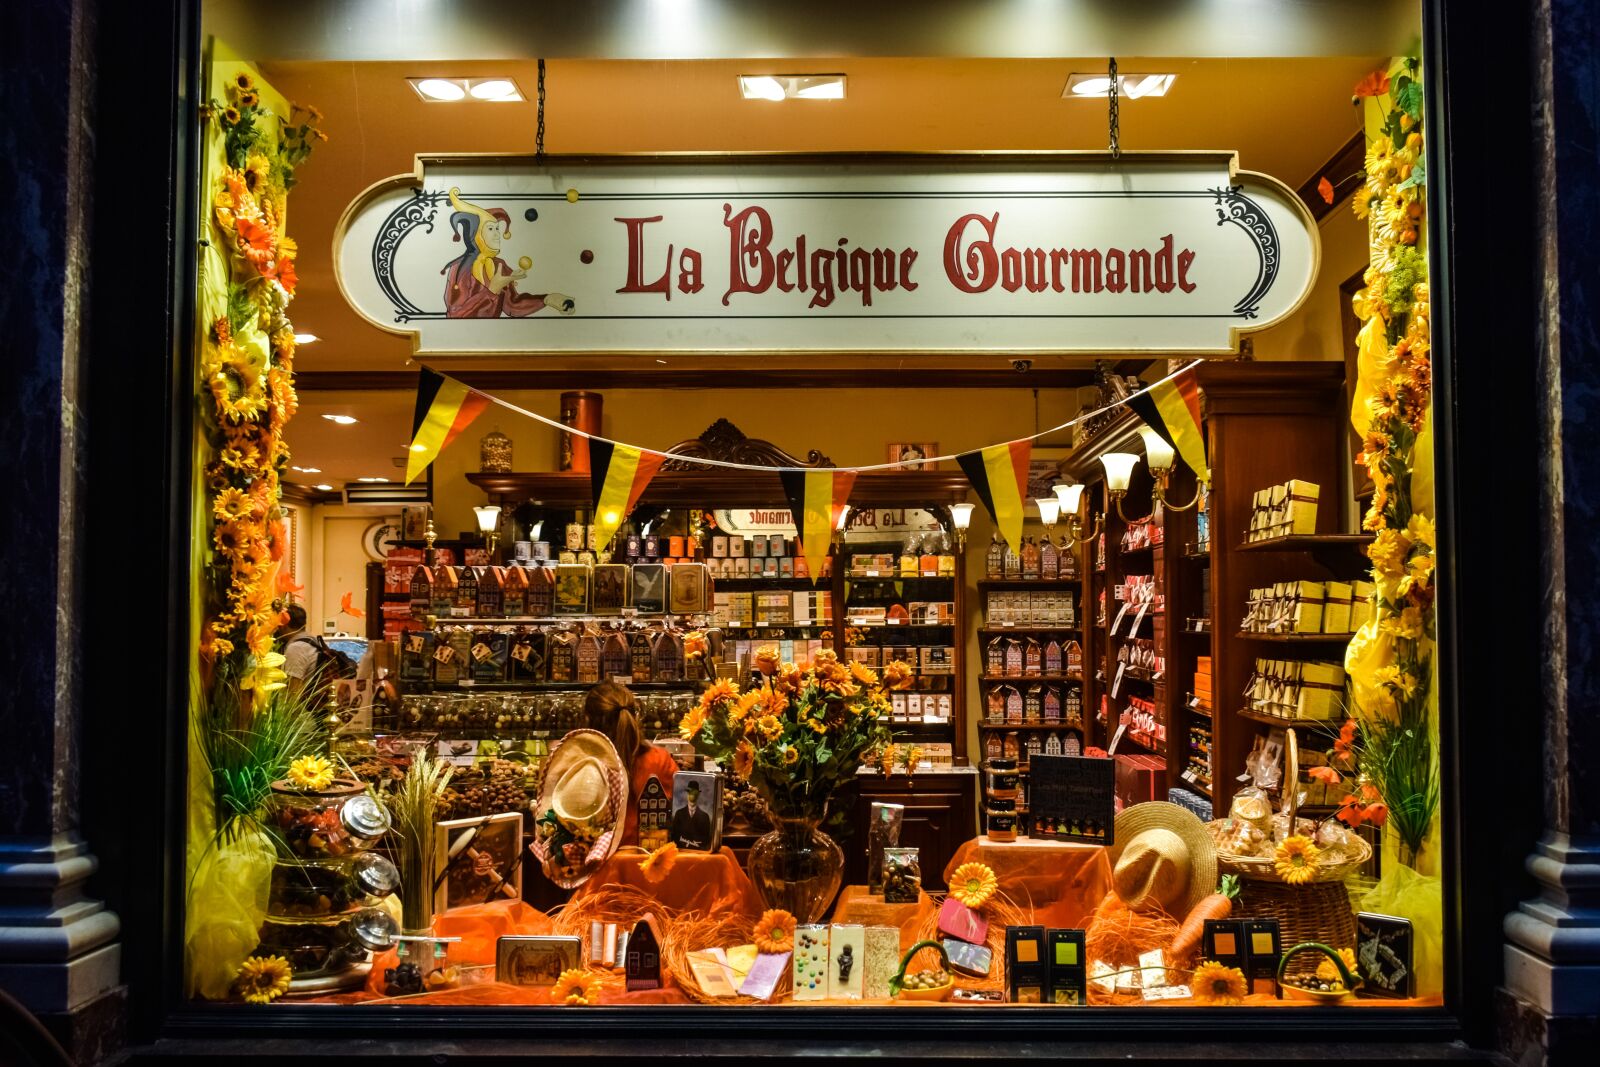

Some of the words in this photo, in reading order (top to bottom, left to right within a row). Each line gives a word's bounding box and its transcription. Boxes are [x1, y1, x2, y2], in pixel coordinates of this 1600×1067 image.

[614, 215, 704, 301] La
[722, 203, 919, 308] Belgique
[943, 211, 1196, 293] Gourmande
